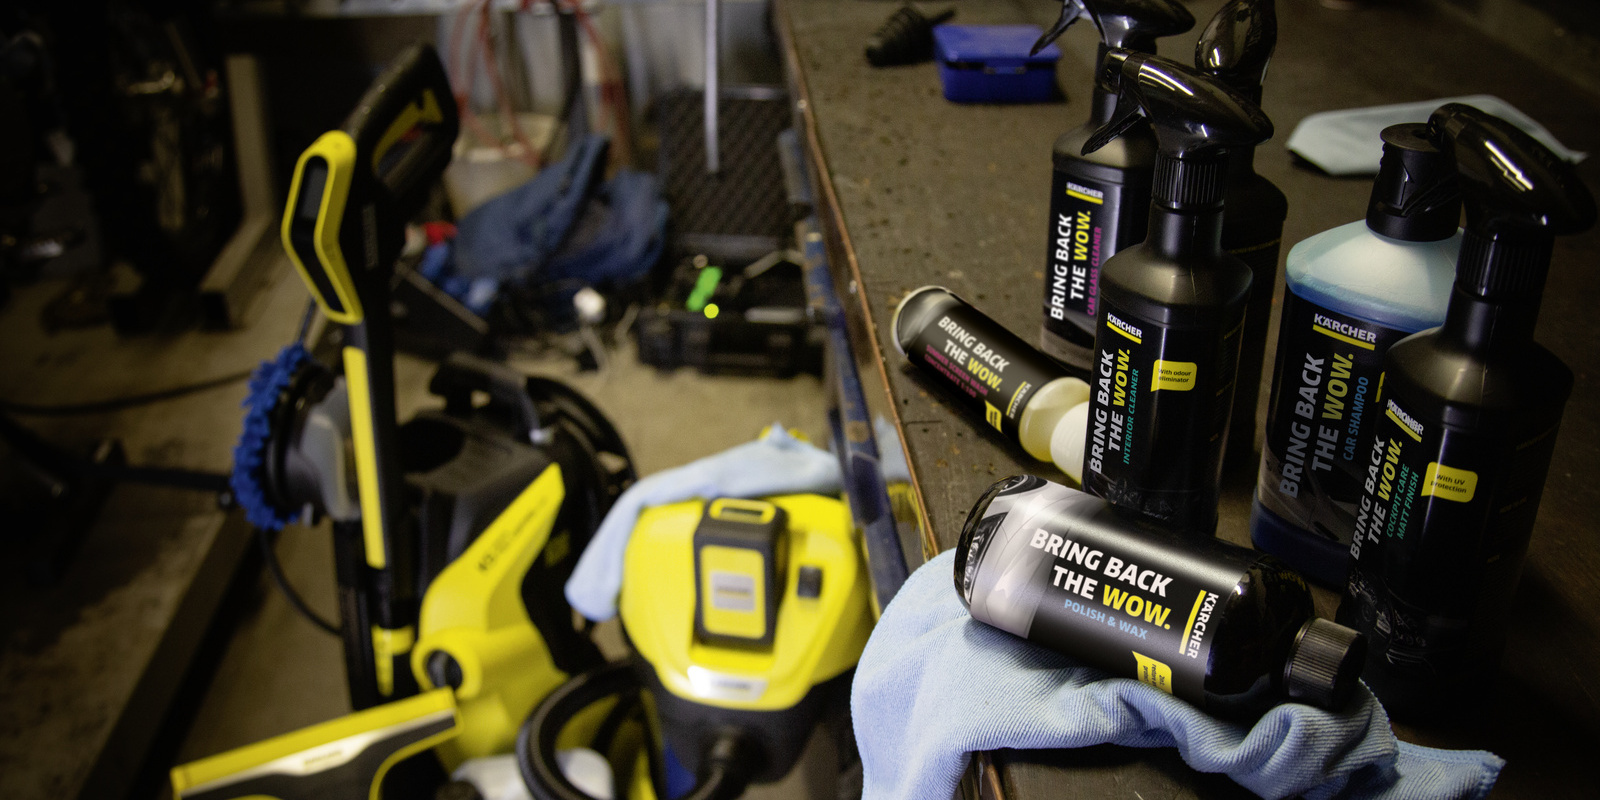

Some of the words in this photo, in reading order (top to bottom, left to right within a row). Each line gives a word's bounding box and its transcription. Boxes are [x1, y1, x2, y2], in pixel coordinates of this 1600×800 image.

[1055, 213, 1072, 262] BACK
[1073, 210, 1091, 261] WOW.
[1091, 227, 1102, 267] CLEANER
[1050, 264, 1068, 320] BRING
[1070, 265, 1086, 300] THE
[1087, 297, 1096, 315] CAR
[1088, 268, 1098, 297] GLASS
[937, 316, 977, 349] BRING
[973, 342, 1010, 372] BACK
[1107, 312, 1142, 339] KÄRCHER
[1313, 313, 1377, 343] KÄRCHER
[944, 339, 968, 365] THE
[968, 357, 1002, 391] WOW.
[1097, 349, 1113, 406] BACK
[1113, 348, 1130, 407] WOW.
[1321, 352, 1354, 421] WOW.
[1128, 369, 1139, 415] CLEANER
[1349, 376, 1369, 432] SHAMPOO
[1090, 408, 1108, 474] BRING
[1108, 410, 1124, 452] THE
[1123, 416, 1134, 464] INTERIOR
[1279, 421, 1311, 498] BRING
[1295, 352, 1325, 420] BACK
[1311, 425, 1339, 472] THE
[1343, 432, 1356, 461] CAR
[1350, 495, 1371, 560] BRING
[1364, 435, 1385, 496] BACK
[1367, 501, 1387, 545] THE
[1377, 437, 1403, 501] WOW.
[1386, 494, 1402, 538] COCKPIT
[1397, 464, 1410, 494] CARE
[1430, 480, 1467, 493] protection
[1436, 474, 1453, 483] With
[1397, 509, 1411, 540] MATT
[1404, 471, 1419, 510] FINISH
[1029, 528, 1103, 570] BRING
[1103, 556, 1173, 597] BACK
[1053, 565, 1098, 600] THE
[1101, 584, 1171, 630] WOW.
[1064, 599, 1106, 623] POLISH
[1107, 616, 1116, 627] &
[1118, 620, 1148, 640] WAX
[1187, 593, 1219, 659] KÄRCHER
